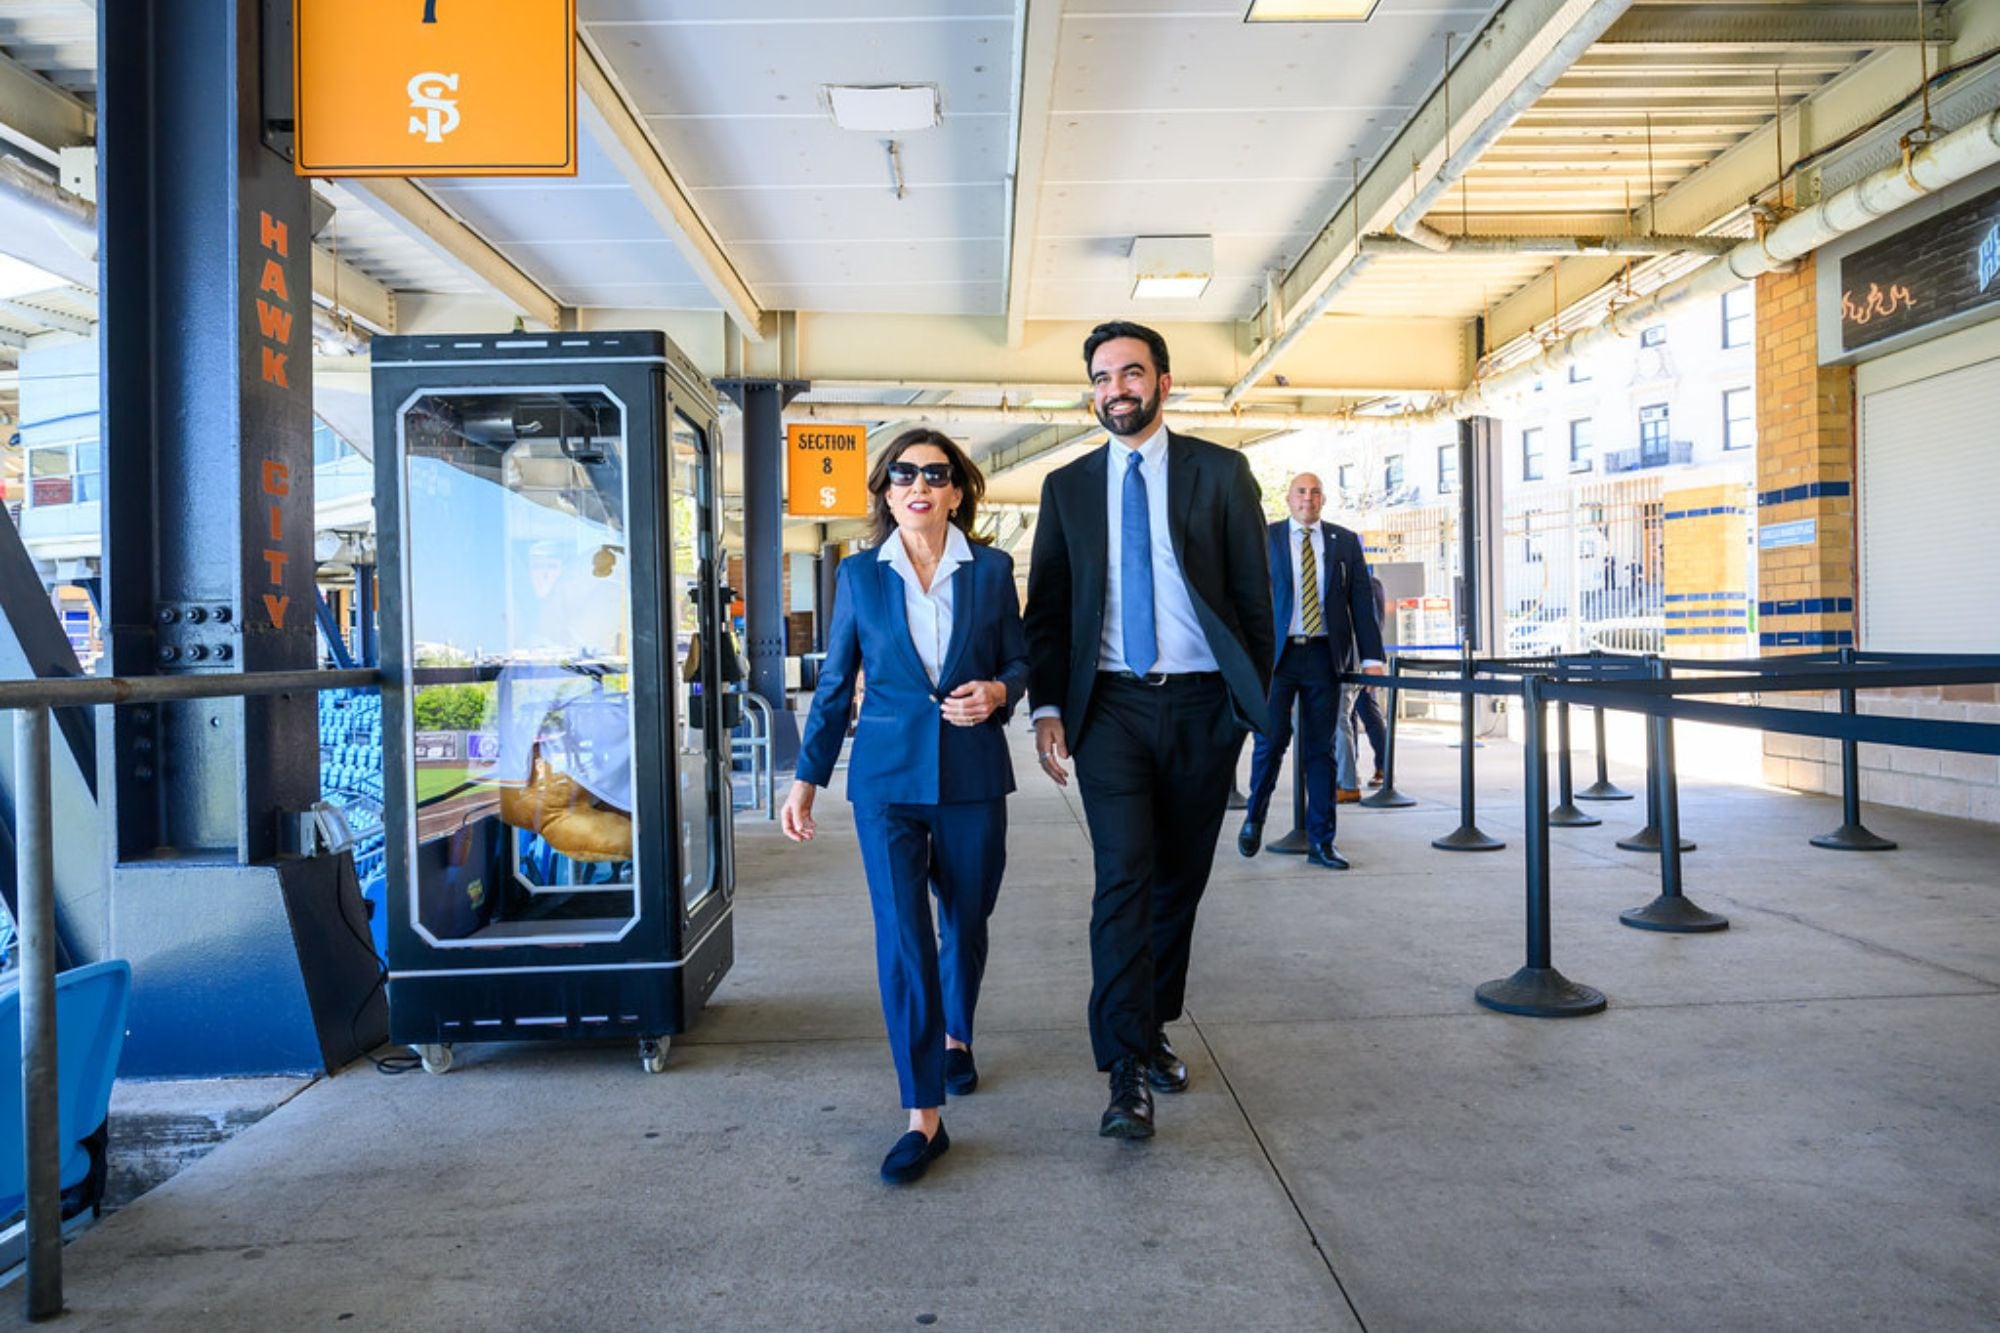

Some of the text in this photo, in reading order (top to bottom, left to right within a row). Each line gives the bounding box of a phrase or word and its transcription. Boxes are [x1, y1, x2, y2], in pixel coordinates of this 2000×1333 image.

[256, 210, 293, 630] HAWK CITY
[798, 434, 856, 451] SECTION
[822, 457, 832, 474] 8
